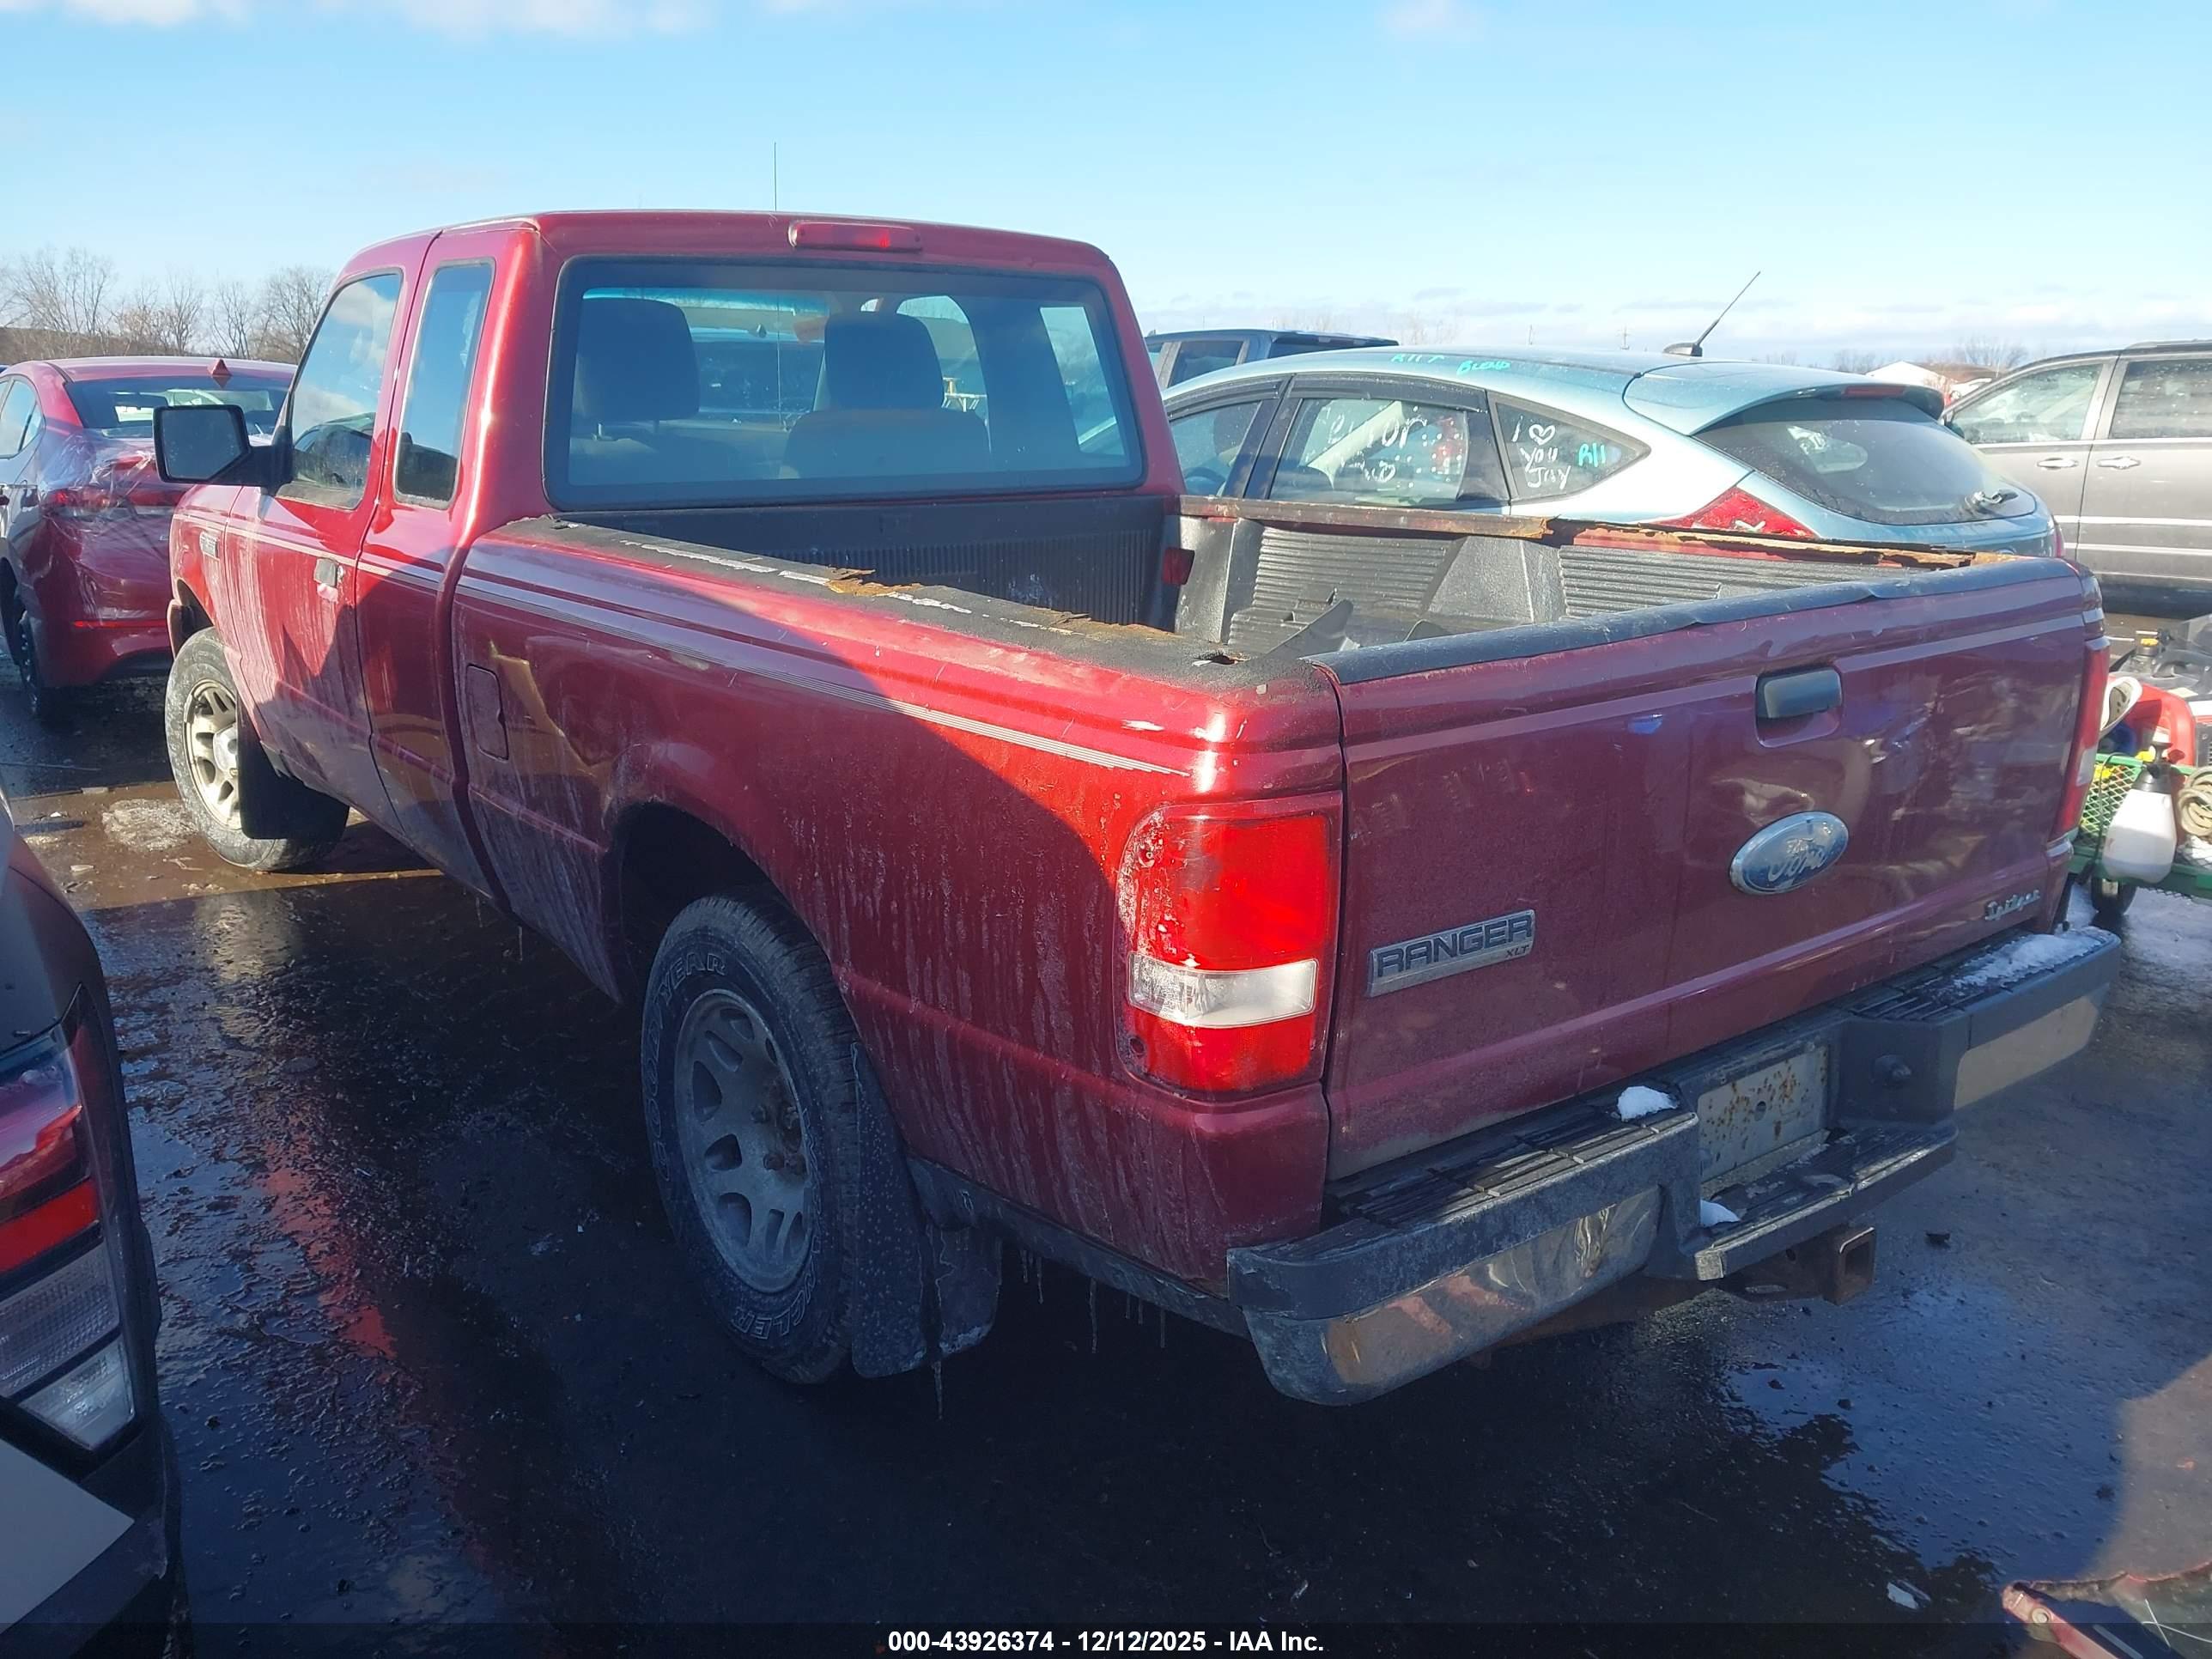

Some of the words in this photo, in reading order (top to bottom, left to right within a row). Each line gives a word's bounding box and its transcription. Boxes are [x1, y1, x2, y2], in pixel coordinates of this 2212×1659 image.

[1767, 837, 1827, 882] Ford
[1377, 915, 1533, 978] RANGER
[1505, 945, 1530, 959] XLT
